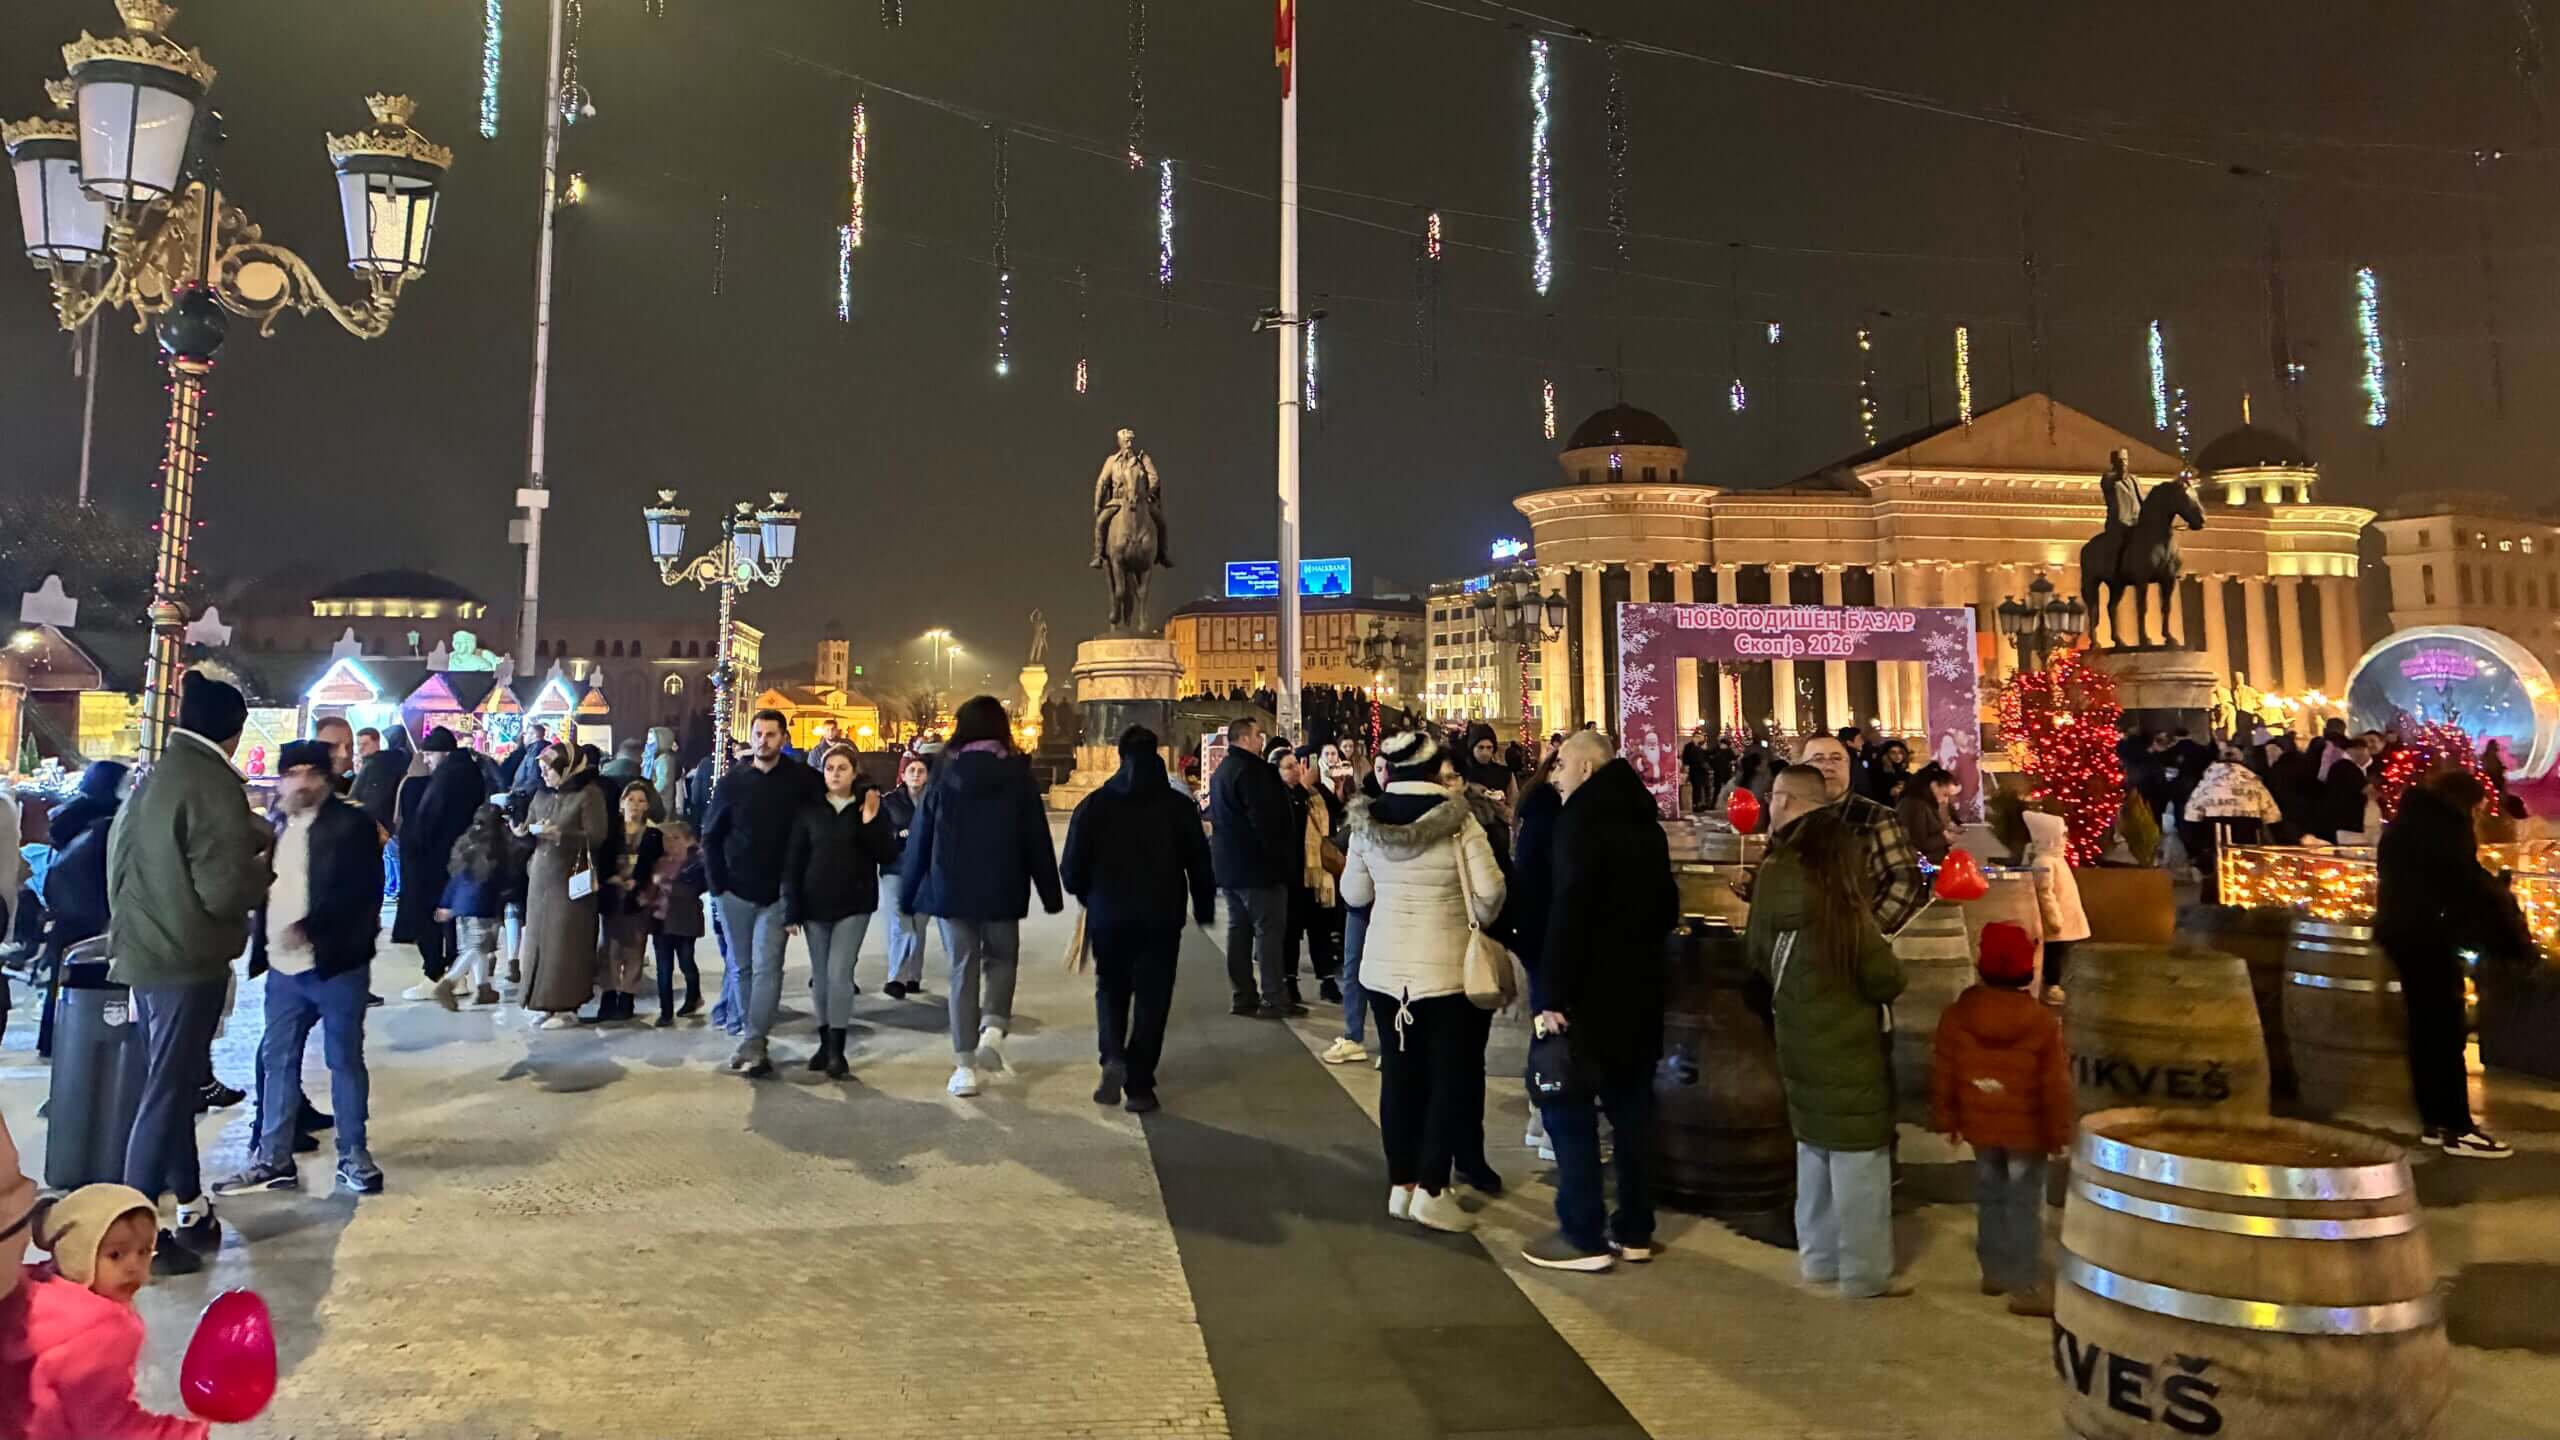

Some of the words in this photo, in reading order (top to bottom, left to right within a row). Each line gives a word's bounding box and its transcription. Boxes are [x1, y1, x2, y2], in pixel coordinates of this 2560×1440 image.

[1678, 609, 1842, 633] НОВОГОДИШЕН
[1846, 612, 1916, 632] БАЗАР
[1735, 634, 1804, 657] Скопје
[1809, 636, 1854, 654] 2026
